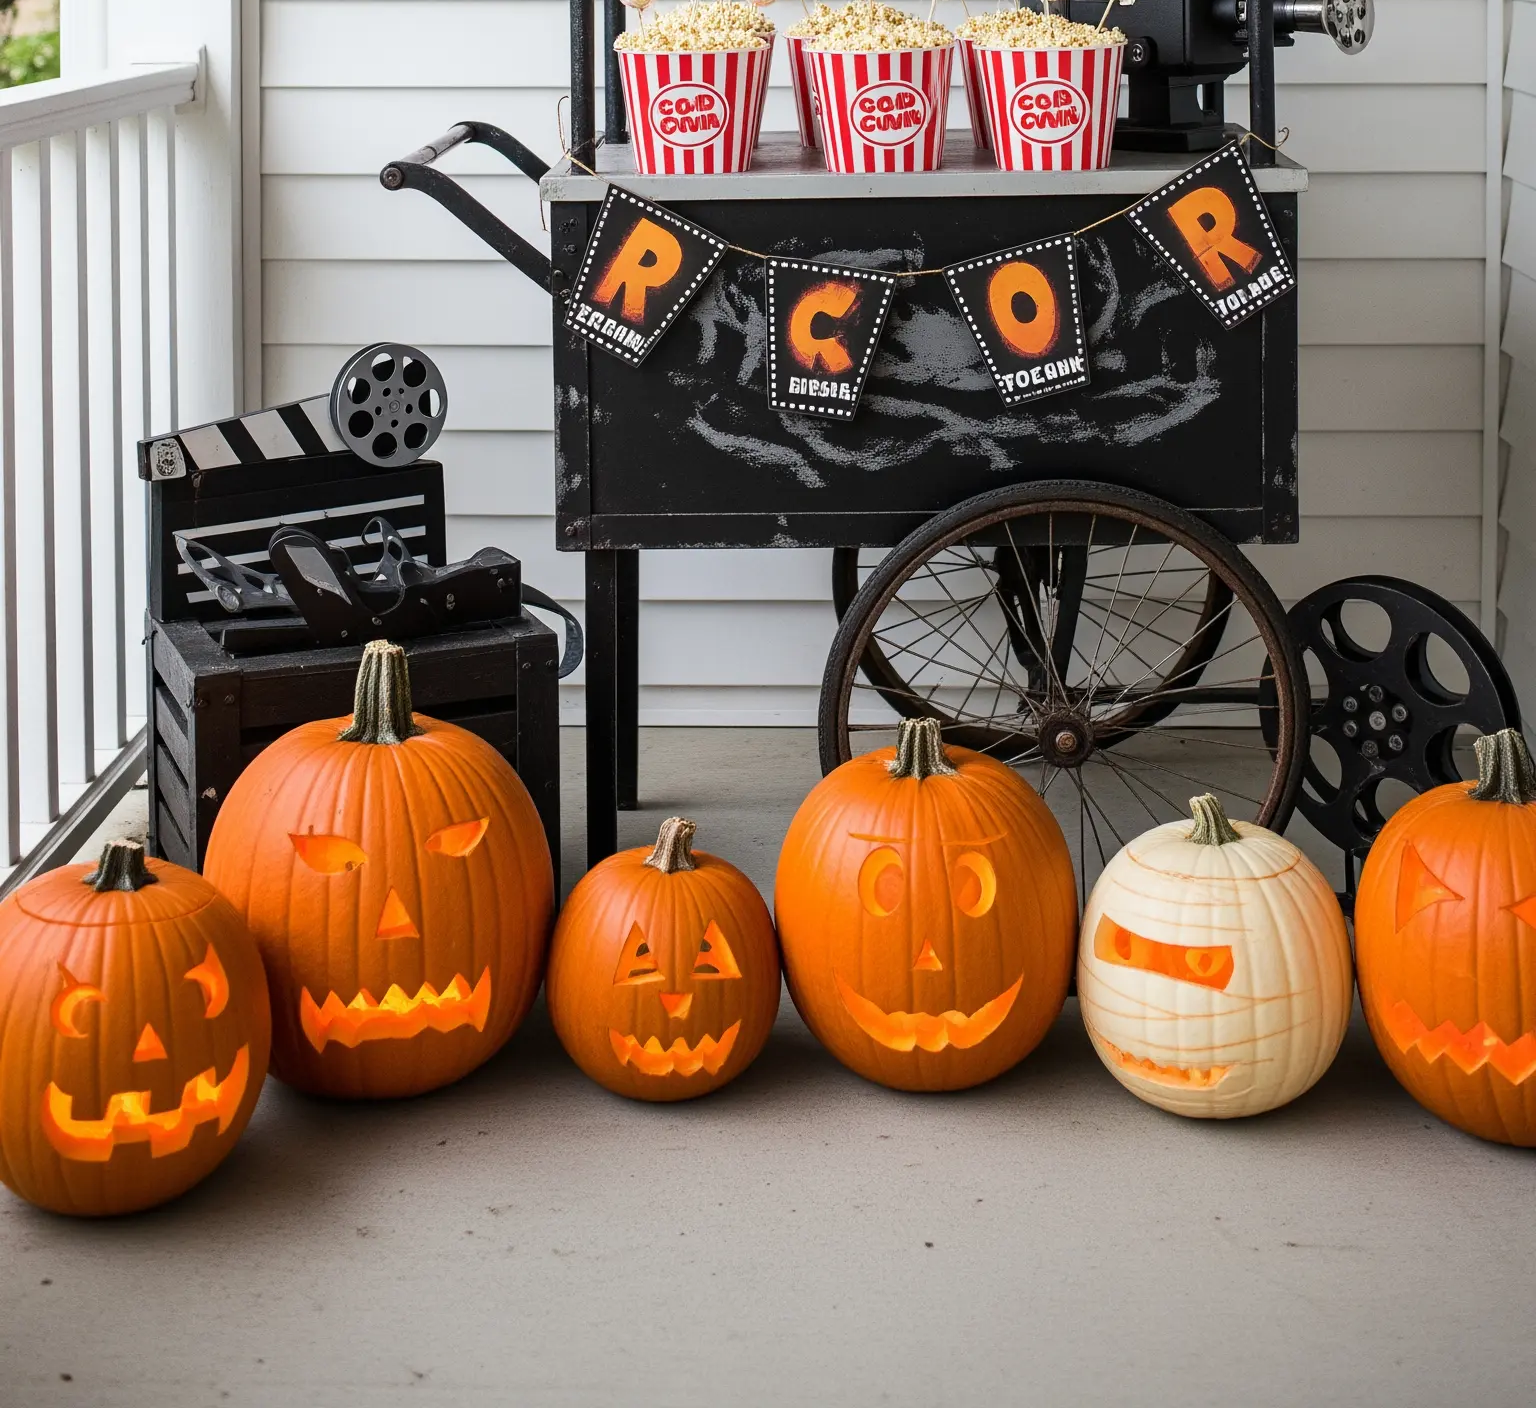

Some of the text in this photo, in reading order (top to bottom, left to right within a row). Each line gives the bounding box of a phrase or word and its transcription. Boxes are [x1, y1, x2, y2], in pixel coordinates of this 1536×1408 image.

[593, 217, 683, 324] R
[1167, 187, 1262, 291] R
[989, 262, 1056, 355] O
